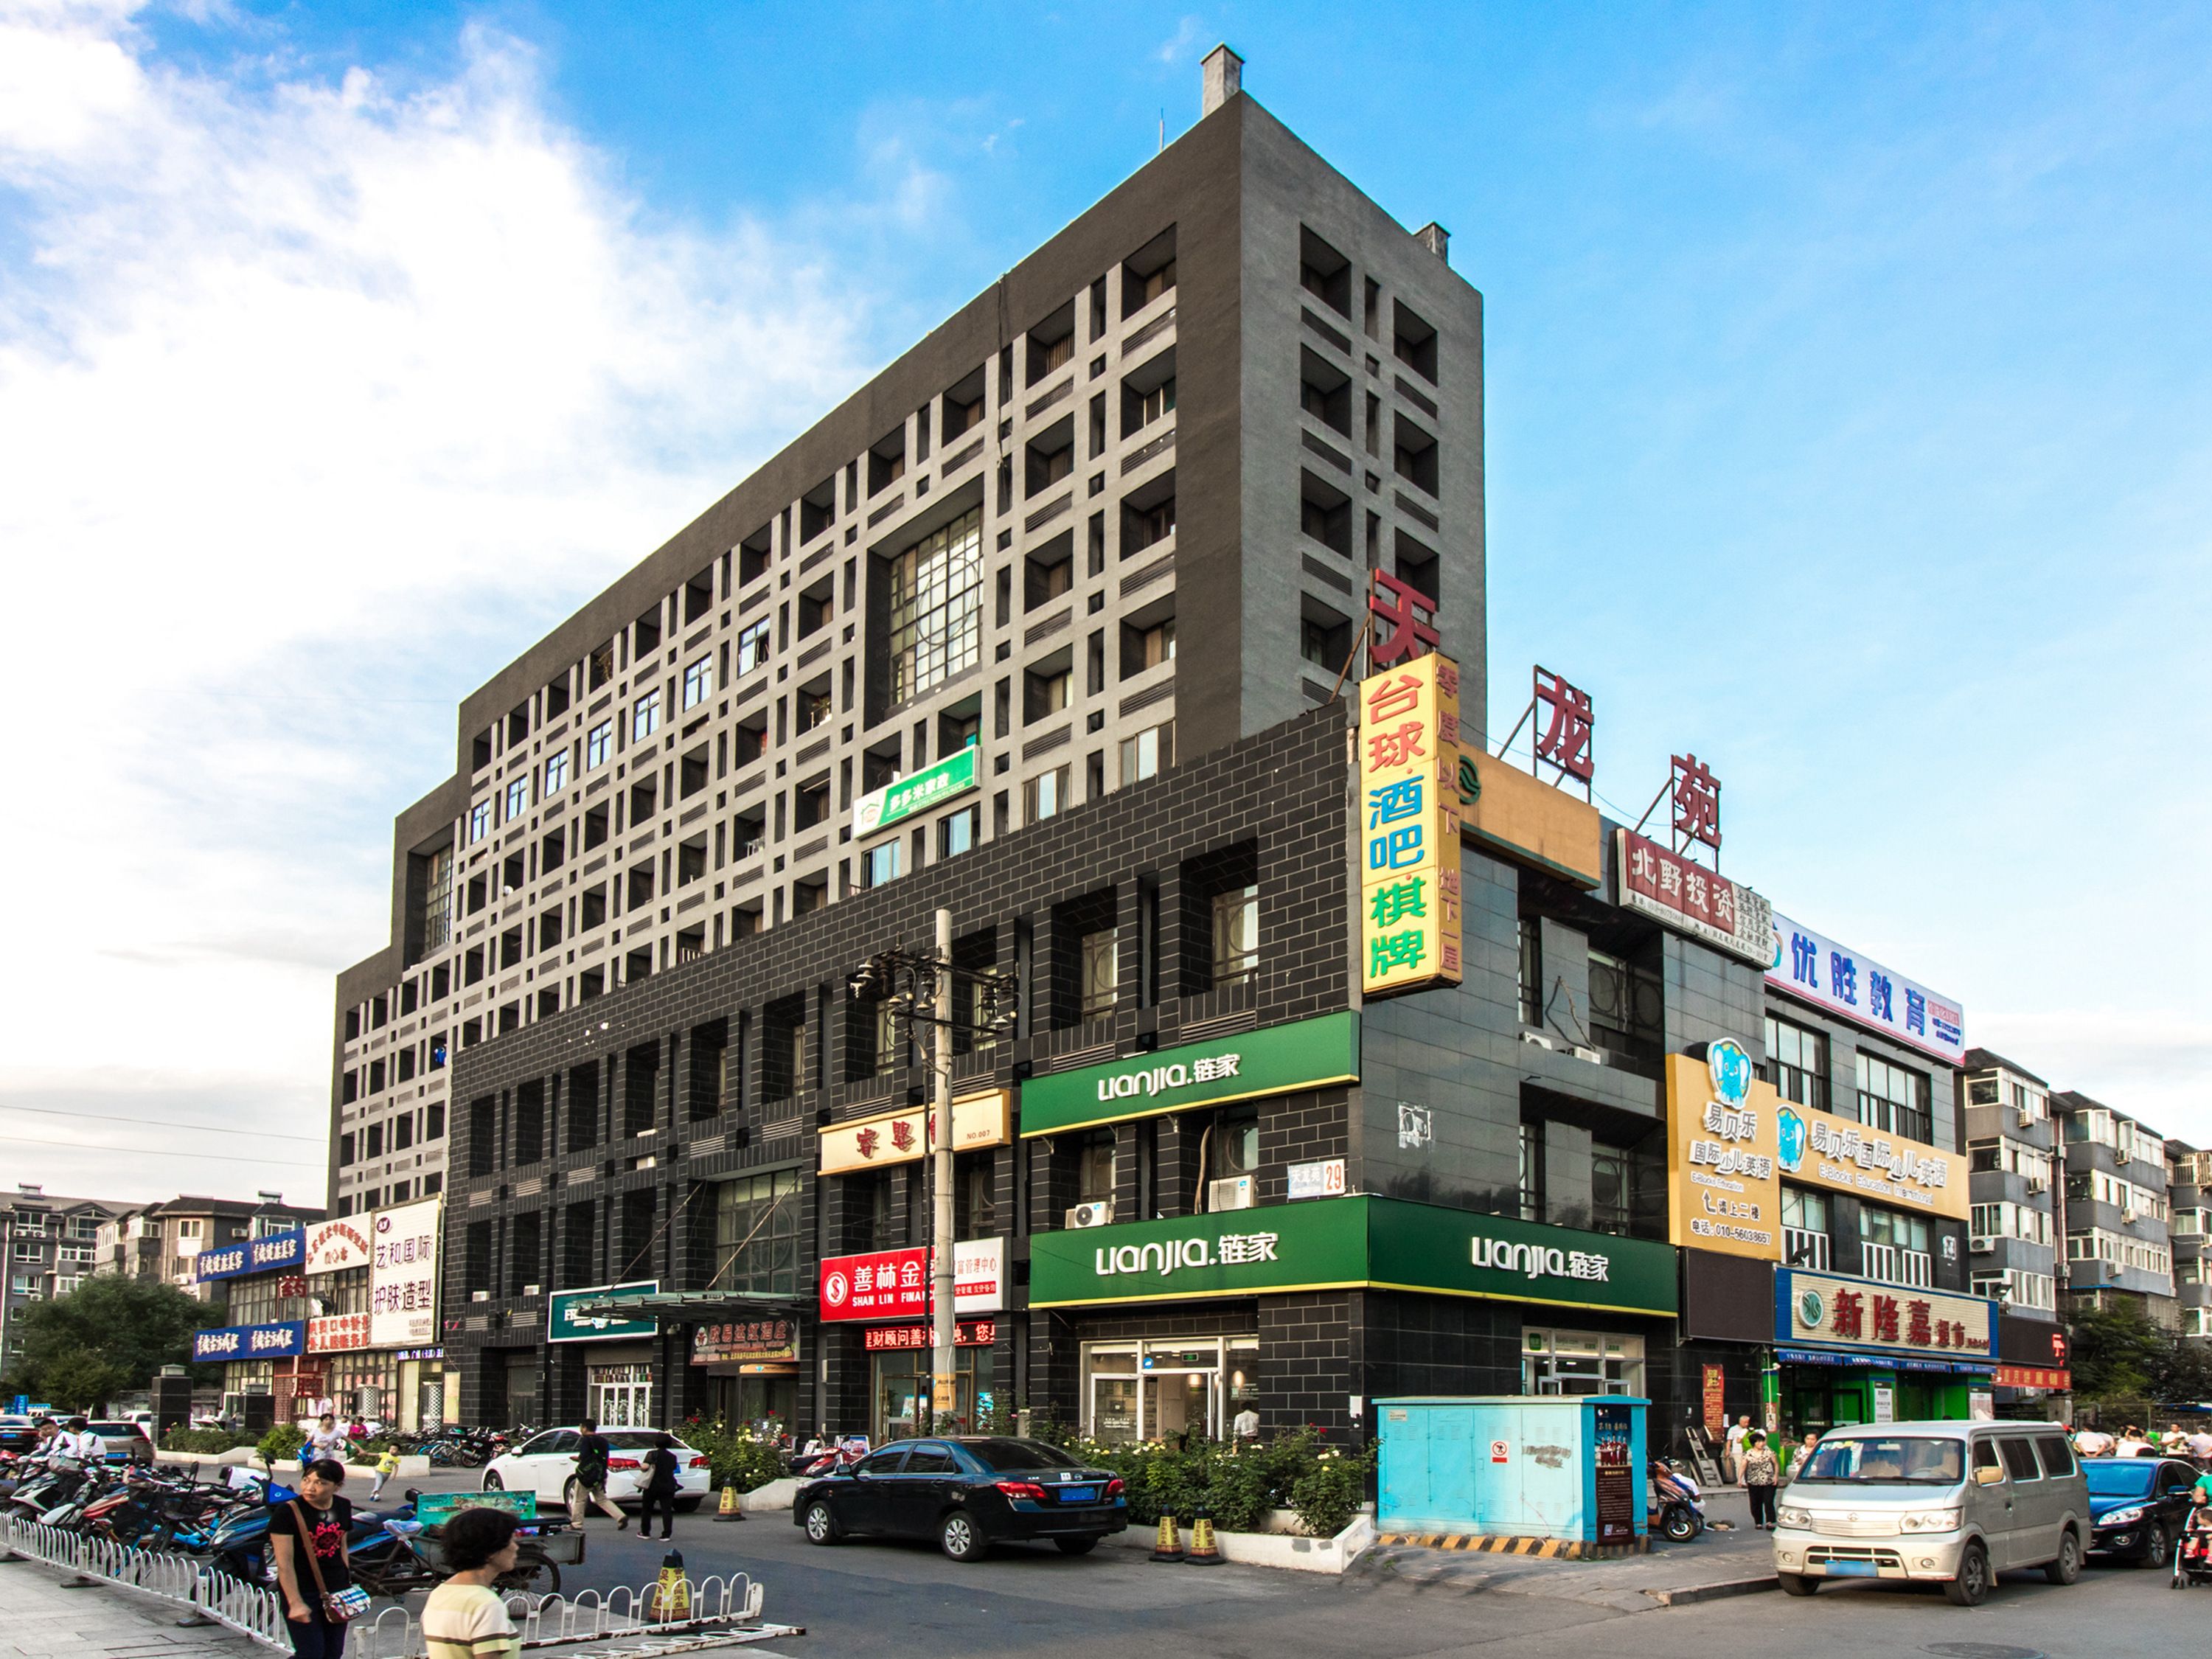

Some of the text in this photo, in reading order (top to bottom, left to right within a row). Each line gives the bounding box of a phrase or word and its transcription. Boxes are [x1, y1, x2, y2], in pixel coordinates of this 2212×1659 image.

[1632, 847, 1734, 922] 北野投资
[1791, 932, 1926, 1037] 优胜教育
[967, 1130, 991, 1140] NO.007
[1704, 1102, 1758, 1143] 易贝乐
[1326, 1164, 1341, 1190] 29
[1689, 1141, 1772, 1180] 国际少儿英语
[1819, 1163, 1853, 1185] E-Blocks
[1856, 1173, 1891, 1194] Education
[1719, 1200, 1760, 1221] 请上二楼
[376, 1235, 432, 1268] 艺和国际
[954, 1257, 996, 1275] 富管理中心
[375, 1279, 432, 1315] 护肤造型
[852, 1295, 874, 1307] SHAN
[879, 1293, 894, 1304] LIN
[1832, 1288, 1965, 1347] 新隆嘉超市
